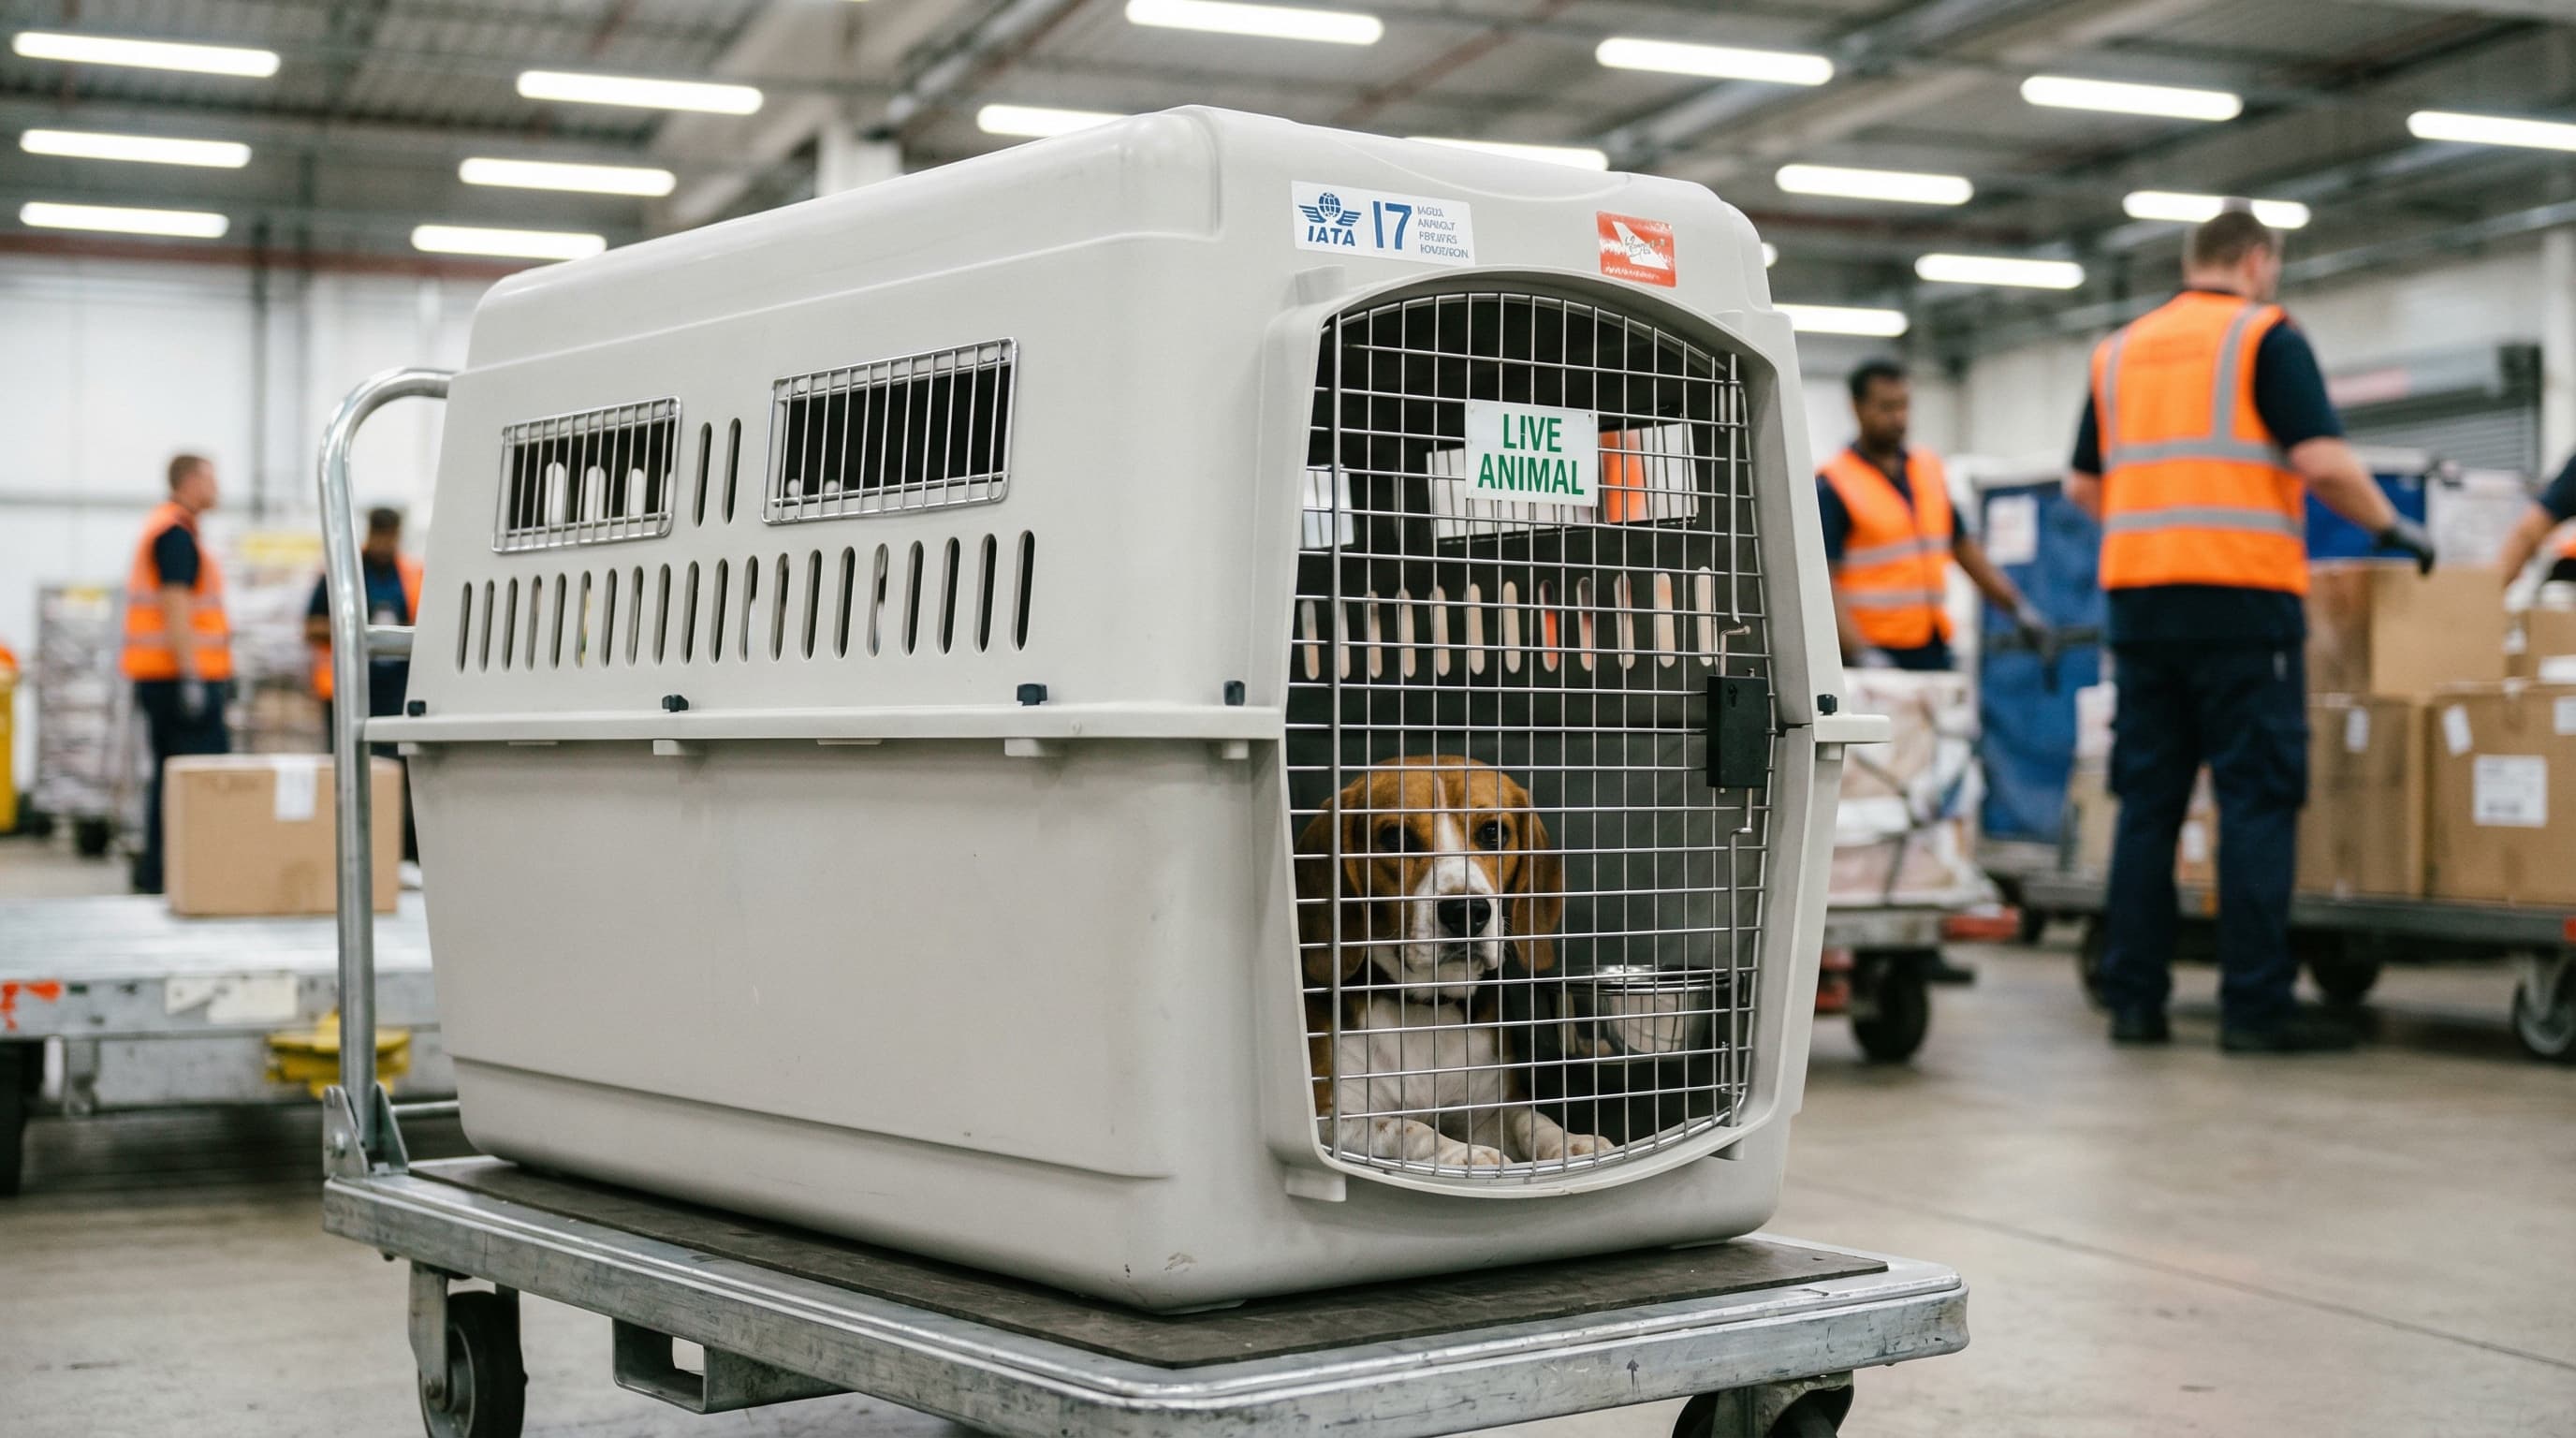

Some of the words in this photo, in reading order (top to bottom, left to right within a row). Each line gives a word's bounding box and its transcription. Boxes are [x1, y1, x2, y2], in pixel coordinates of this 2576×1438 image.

[1308, 226, 1355, 246] IATA
[1503, 414, 1562, 453] LIVE
[1477, 453, 1585, 495] ANIMAL
